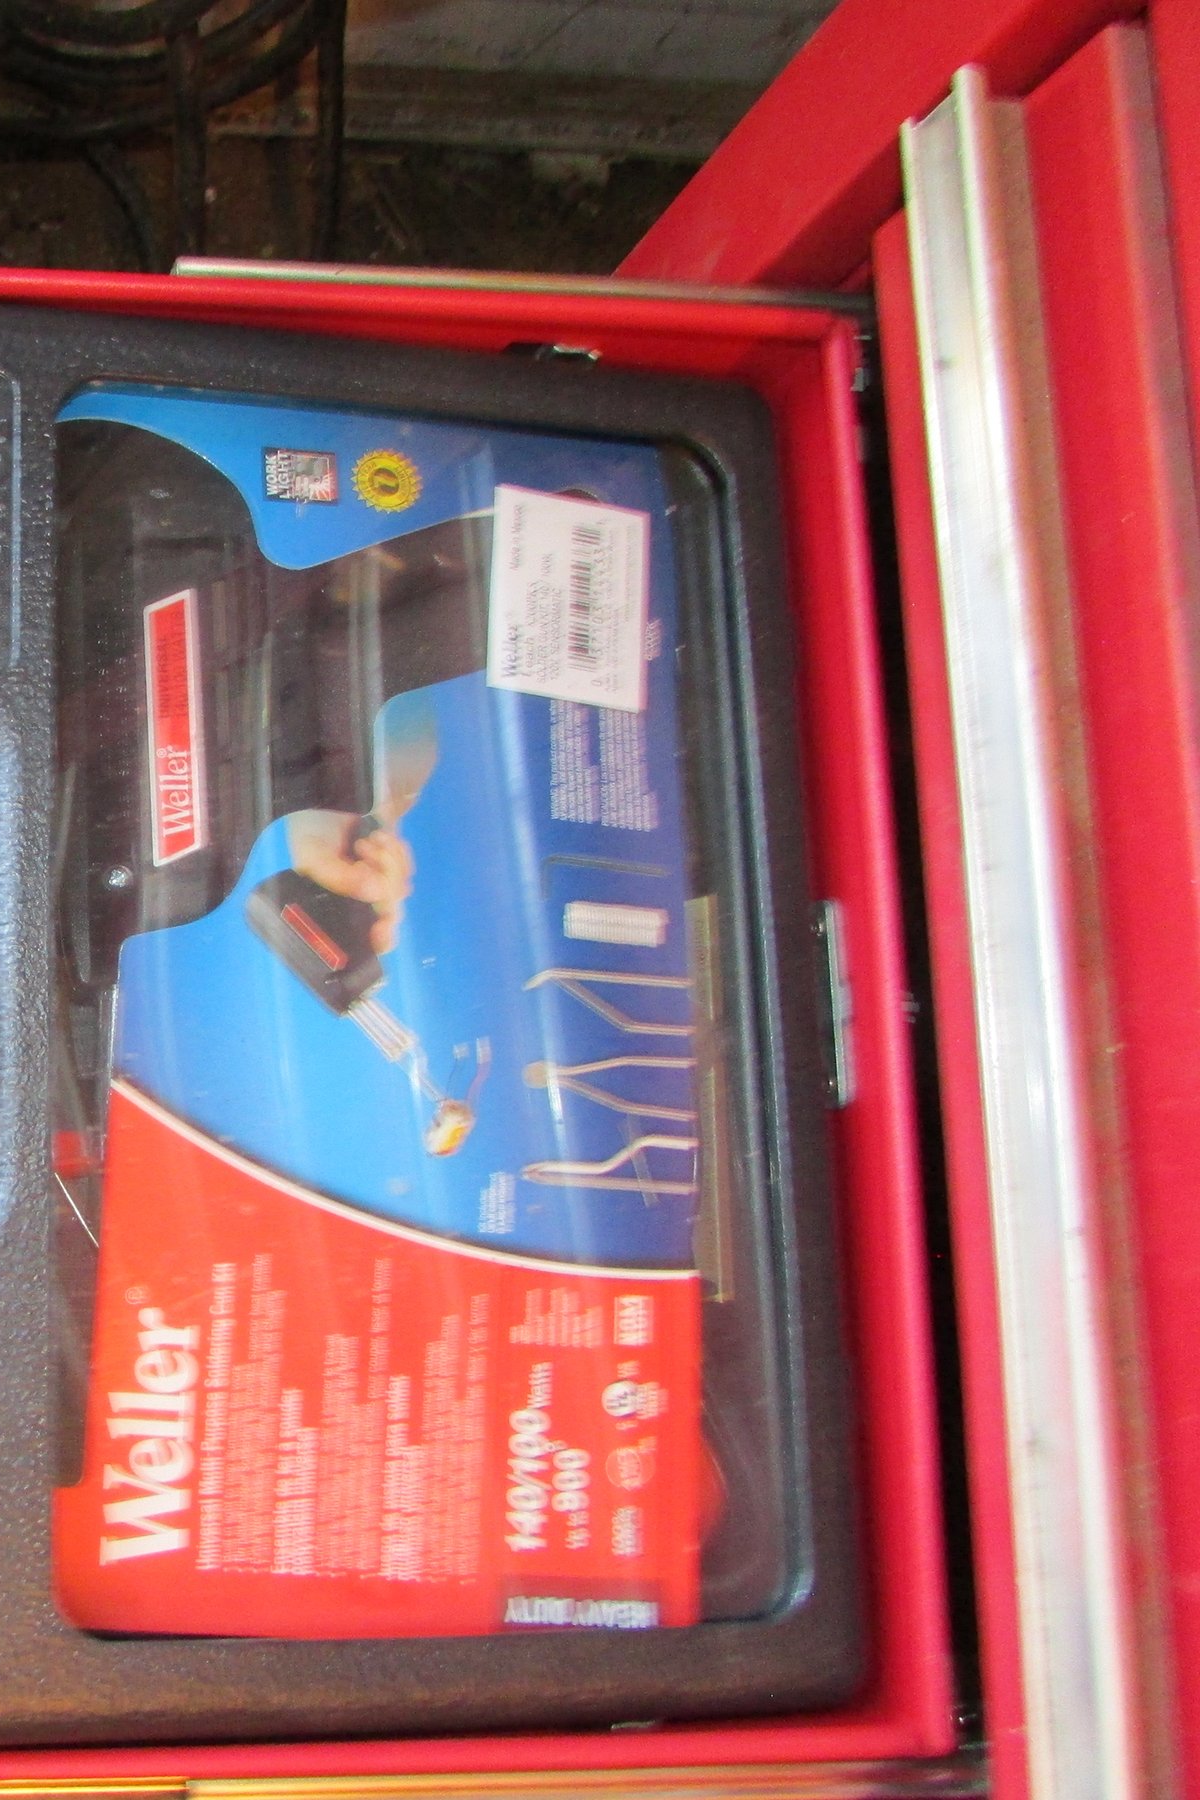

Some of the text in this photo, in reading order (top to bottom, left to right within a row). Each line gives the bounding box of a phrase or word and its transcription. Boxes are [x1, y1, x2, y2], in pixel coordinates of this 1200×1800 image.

[265, 454, 277, 495] WORK
[278, 450, 290, 498] LIGHT
[510, 504, 524, 535] Mexico
[509, 549, 521, 570] Made
[550, 587, 562, 655] SENSORMATIC
[501, 624, 519, 679] Weller
[523, 637, 535, 669] each
[536, 646, 548, 683] SOLDER
[156, 635, 171, 719] UNIVERSAL
[157, 745, 193, 837] Weller
[211, 1263, 237, 1282] Kit
[208, 1285, 236, 1315] Gun
[204, 1318, 237, 1388] Soldering
[277, 1388, 302, 1439] souder
[385, 1375, 410, 1421] soldar
[99, 1307, 200, 1566] Weller
[197, 1391, 230, 1496] Multi-Purpose
[503, 1361, 553, 1552] 140/100 Watts
[273, 1478, 294, 1497] de
[195, 1499, 223, 1570] Universal
[565, 1528, 591, 1549] Up
[566, 1512, 590, 1526] to
